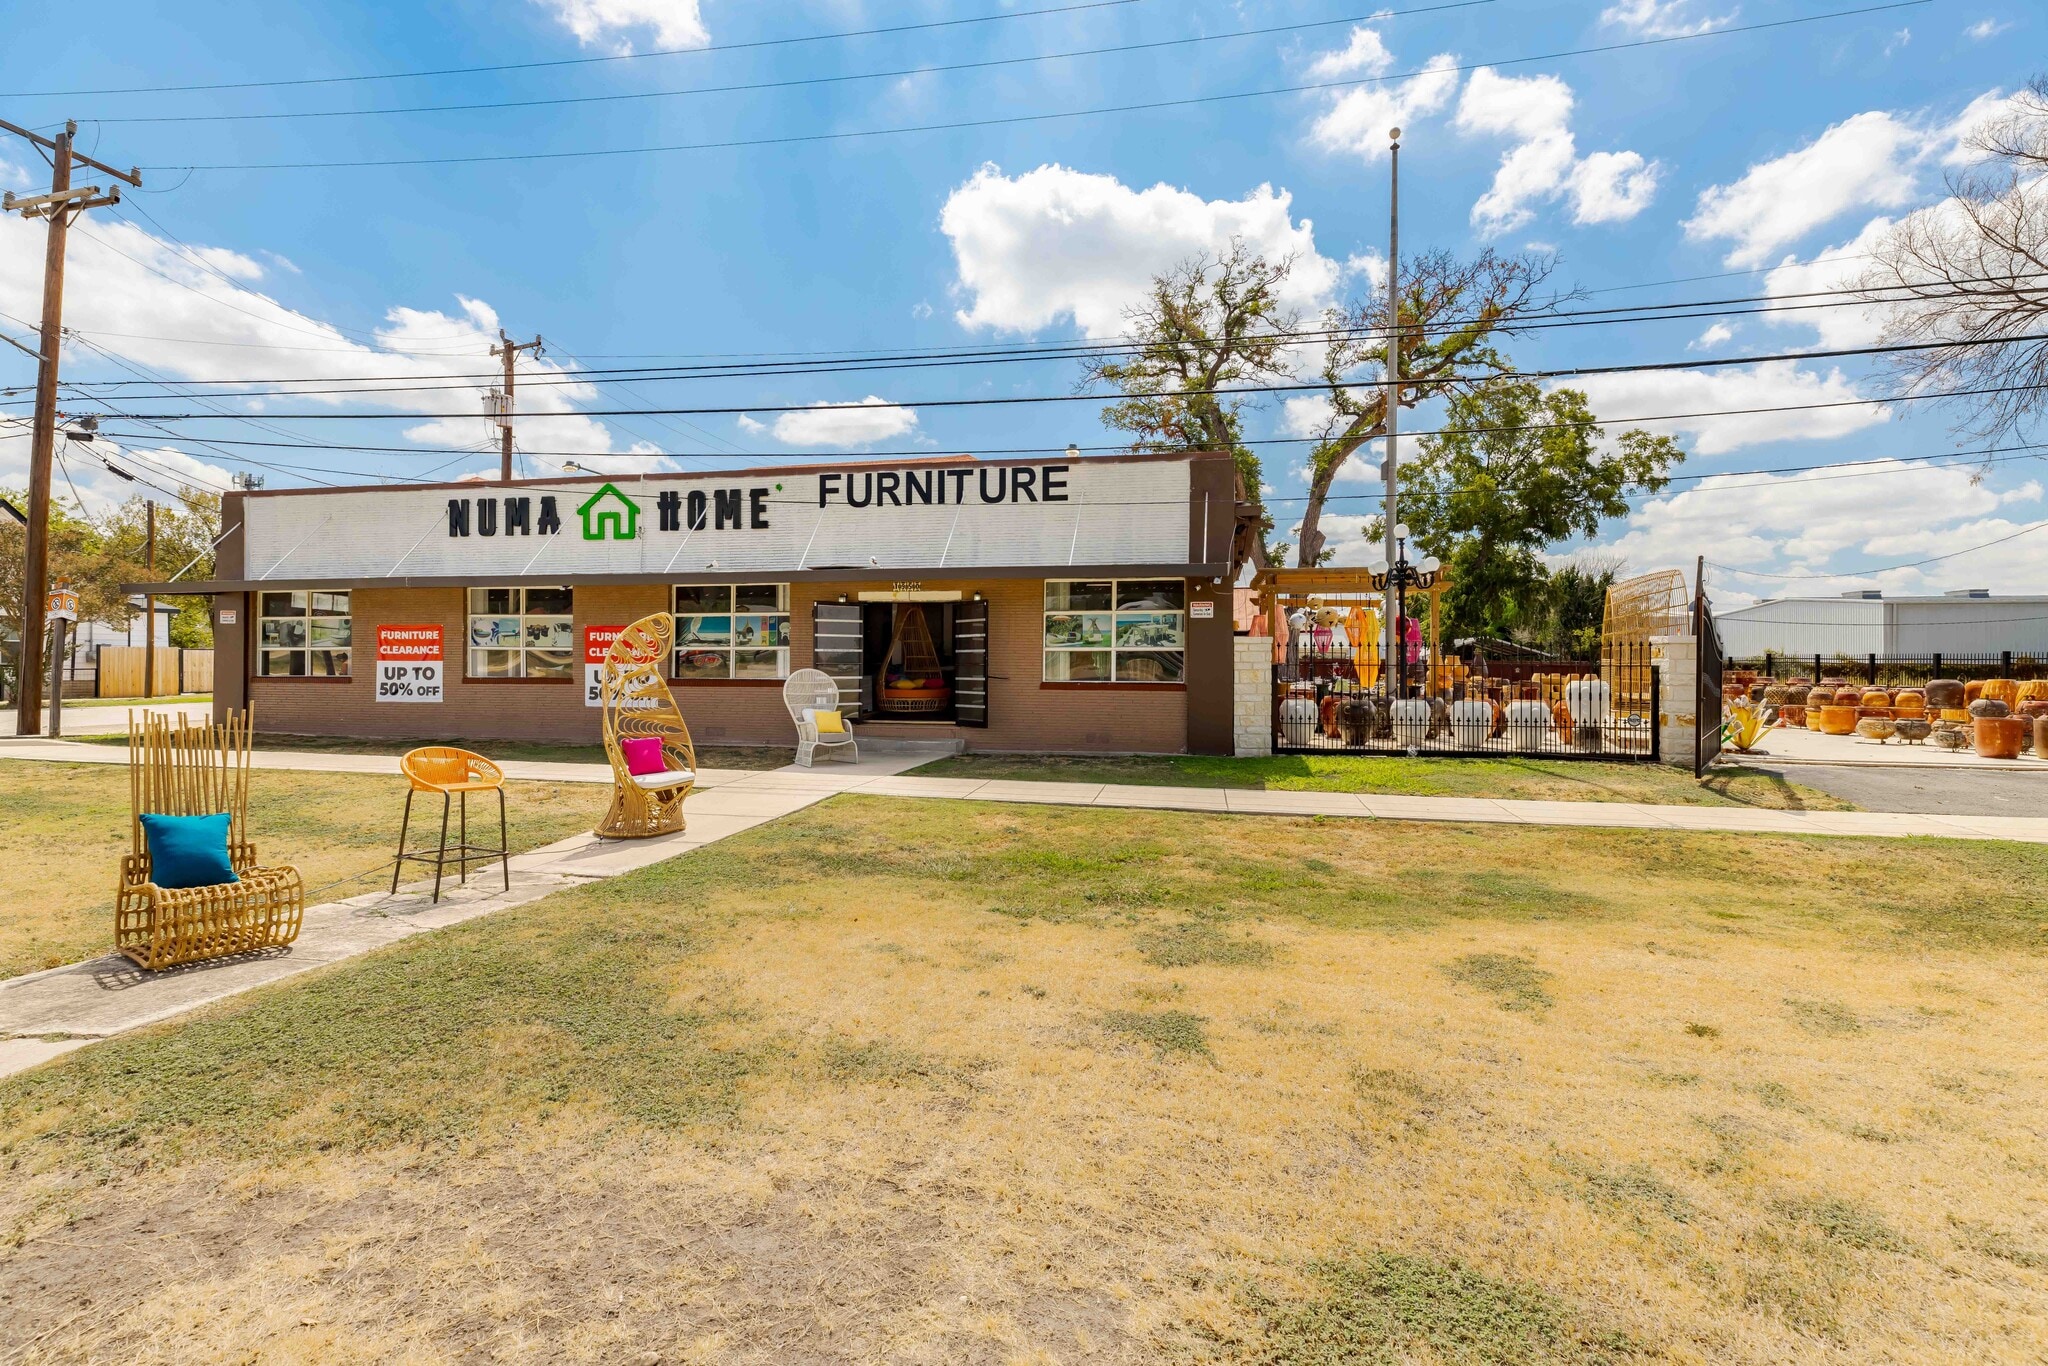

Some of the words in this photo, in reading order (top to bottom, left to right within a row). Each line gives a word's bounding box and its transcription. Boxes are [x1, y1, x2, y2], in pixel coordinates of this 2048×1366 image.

[448, 496, 560, 537] NUMA
[657, 488, 770, 531] HOME
[819, 466, 1069, 508] FURNITURE
[381, 630, 439, 640] FURNITURE
[380, 645, 439, 655] CLEARANCE
[384, 666, 407, 680] UP
[411, 666, 435, 680] TO
[379, 682, 413, 696] 50%
[417, 685, 440, 696] OFF
